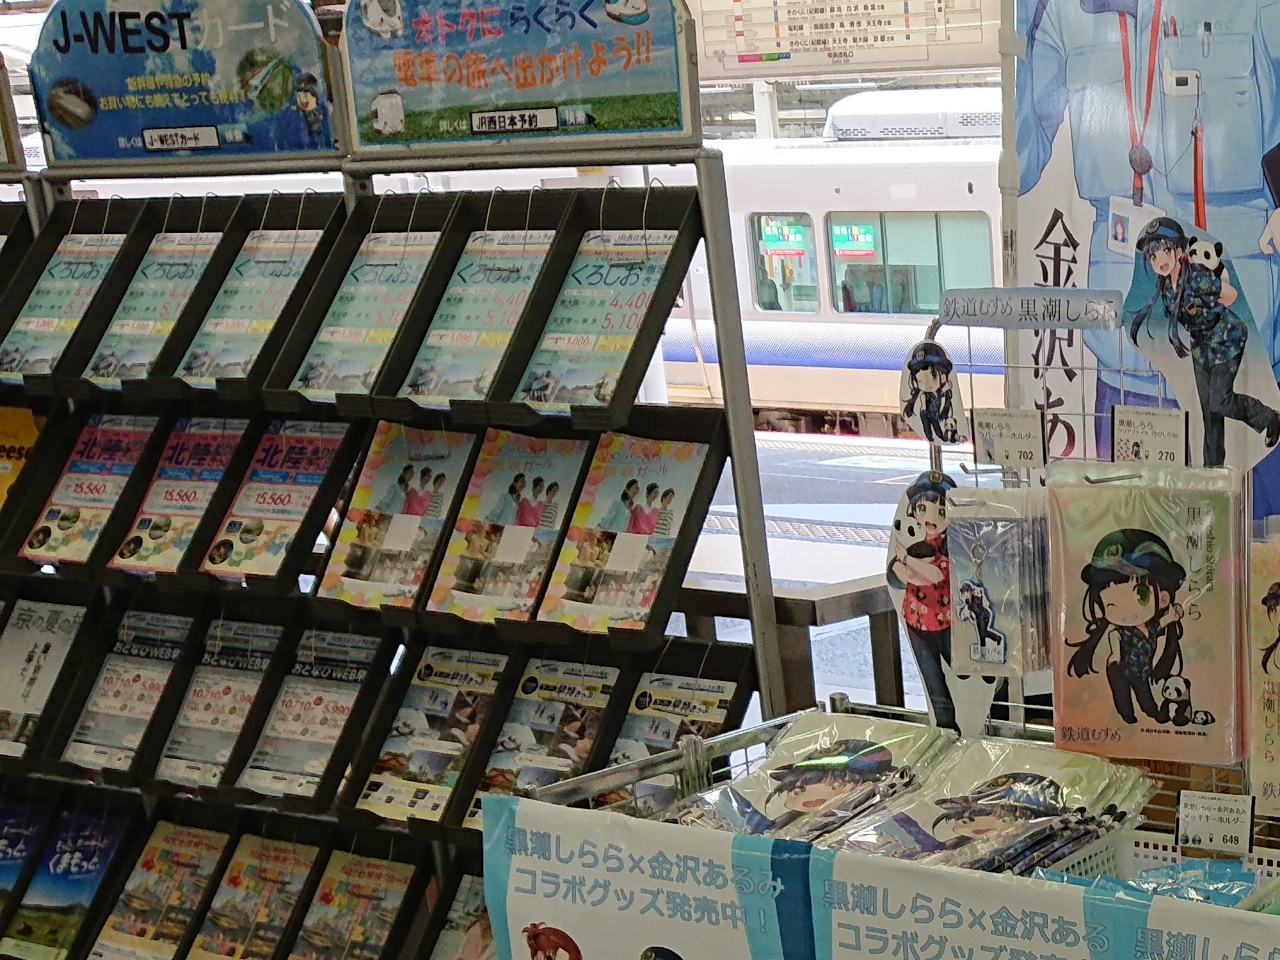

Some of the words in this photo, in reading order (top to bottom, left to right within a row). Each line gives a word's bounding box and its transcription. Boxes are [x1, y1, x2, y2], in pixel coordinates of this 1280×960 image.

[53, 2, 290, 54] J-WESTカード
[571, 264, 643, 287] くろしお
[943, 297, 1013, 324] 鉄道むすめ
[1018, 450, 1034, 461] 702
[1158, 450, 1175, 462] 270
[1222, 834, 1240, 846] 648
[505, 826, 785, 899] 黒潮しらら×金沢あるみ
